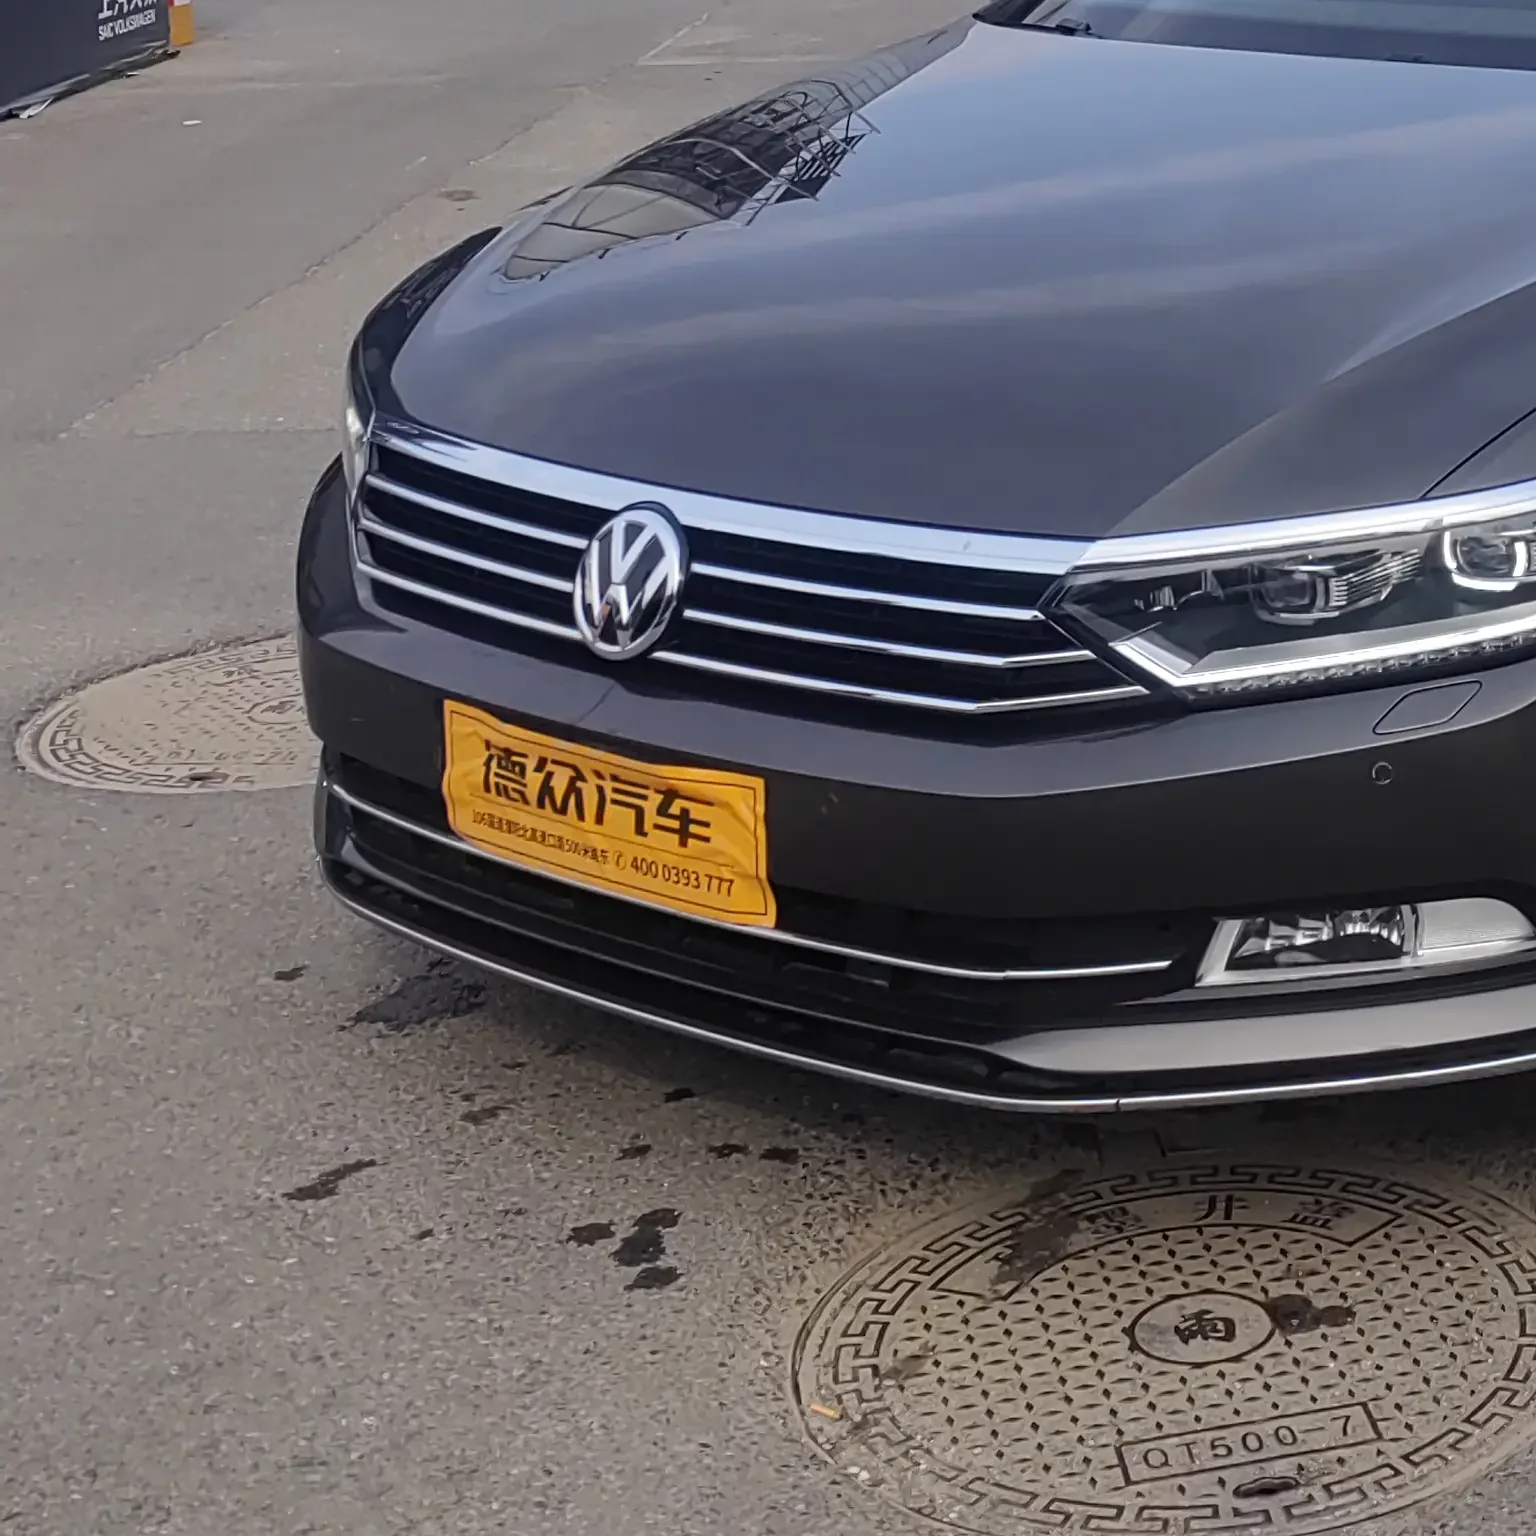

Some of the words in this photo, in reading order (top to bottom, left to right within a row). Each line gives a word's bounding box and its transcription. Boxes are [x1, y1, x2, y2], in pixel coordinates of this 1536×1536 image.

[483, 739, 716, 849] 德众汽车
[1142, 1415, 1351, 1470] QT500-7
